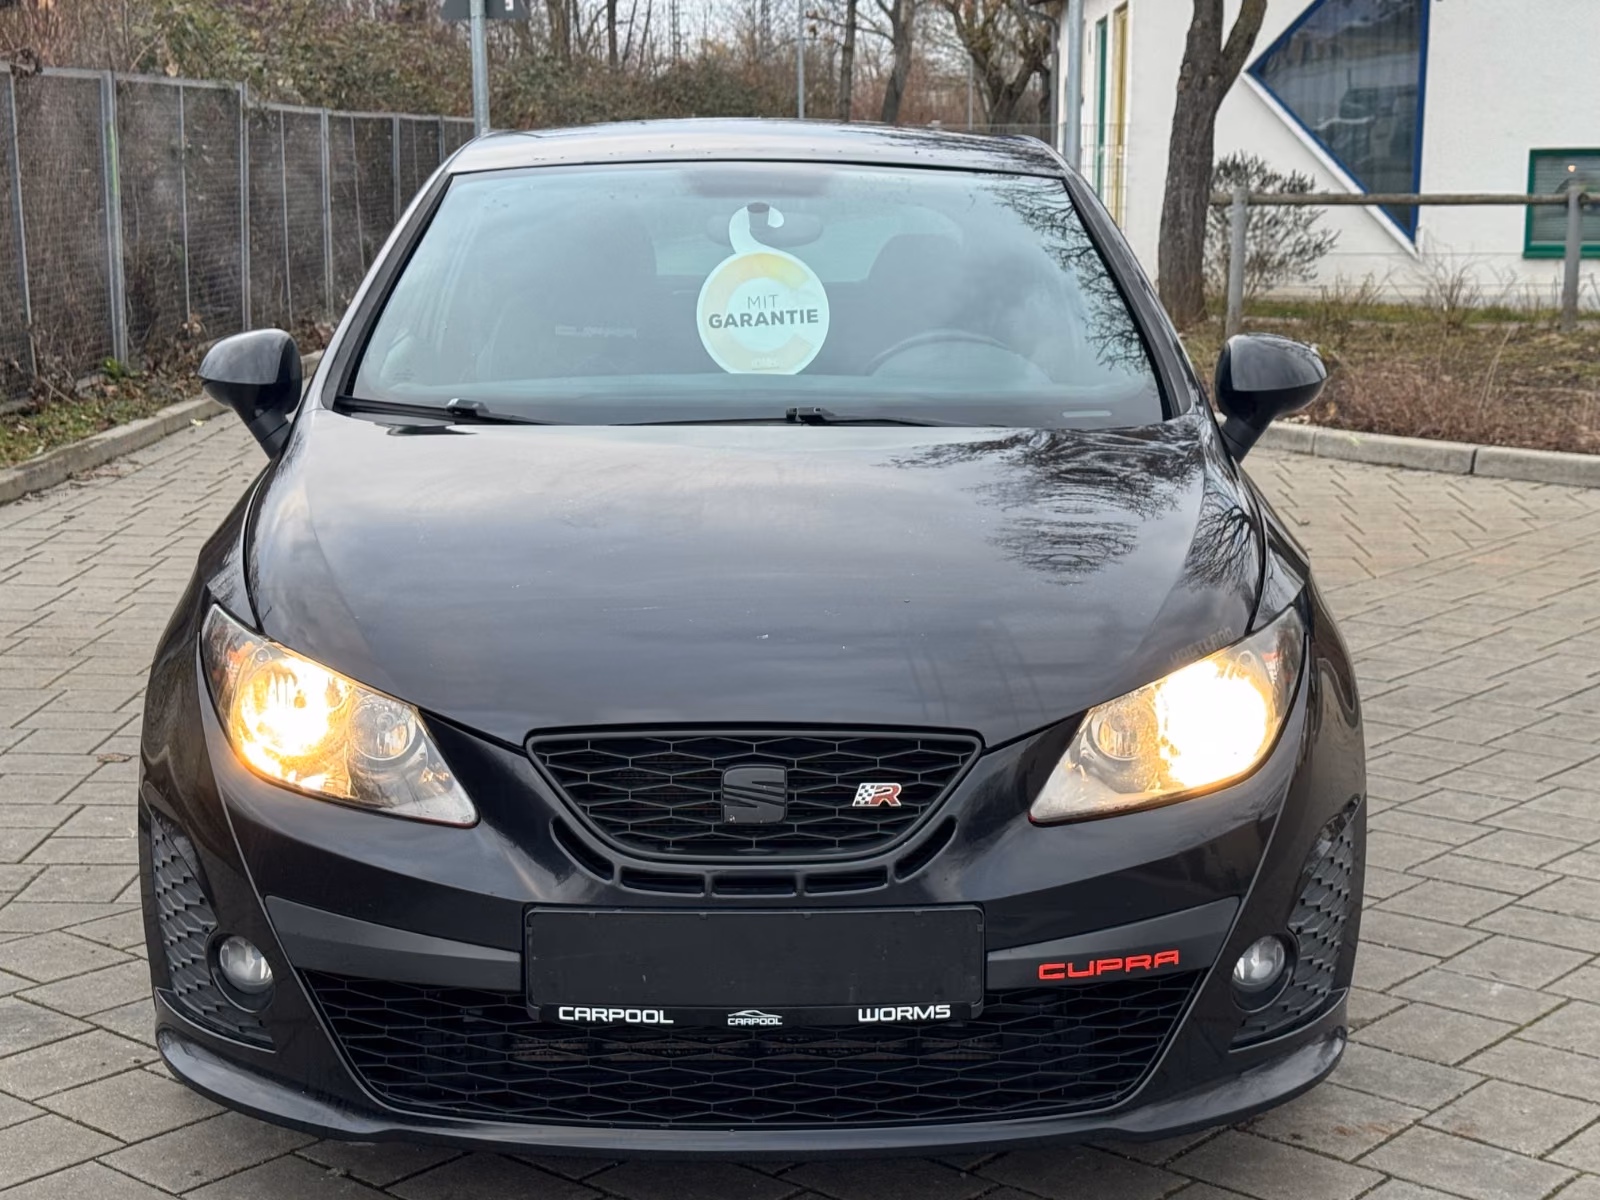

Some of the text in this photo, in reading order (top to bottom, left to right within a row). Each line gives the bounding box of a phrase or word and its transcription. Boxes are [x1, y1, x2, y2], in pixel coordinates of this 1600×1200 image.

[747, 294, 779, 309] MIT
[708, 309, 819, 328] GARANTIE
[1038, 949, 1179, 980] CUPRA
[558, 1006, 674, 1024] CARPOOL
[727, 1017, 783, 1026] CARPOOL
[857, 1005, 952, 1022] WORMS
